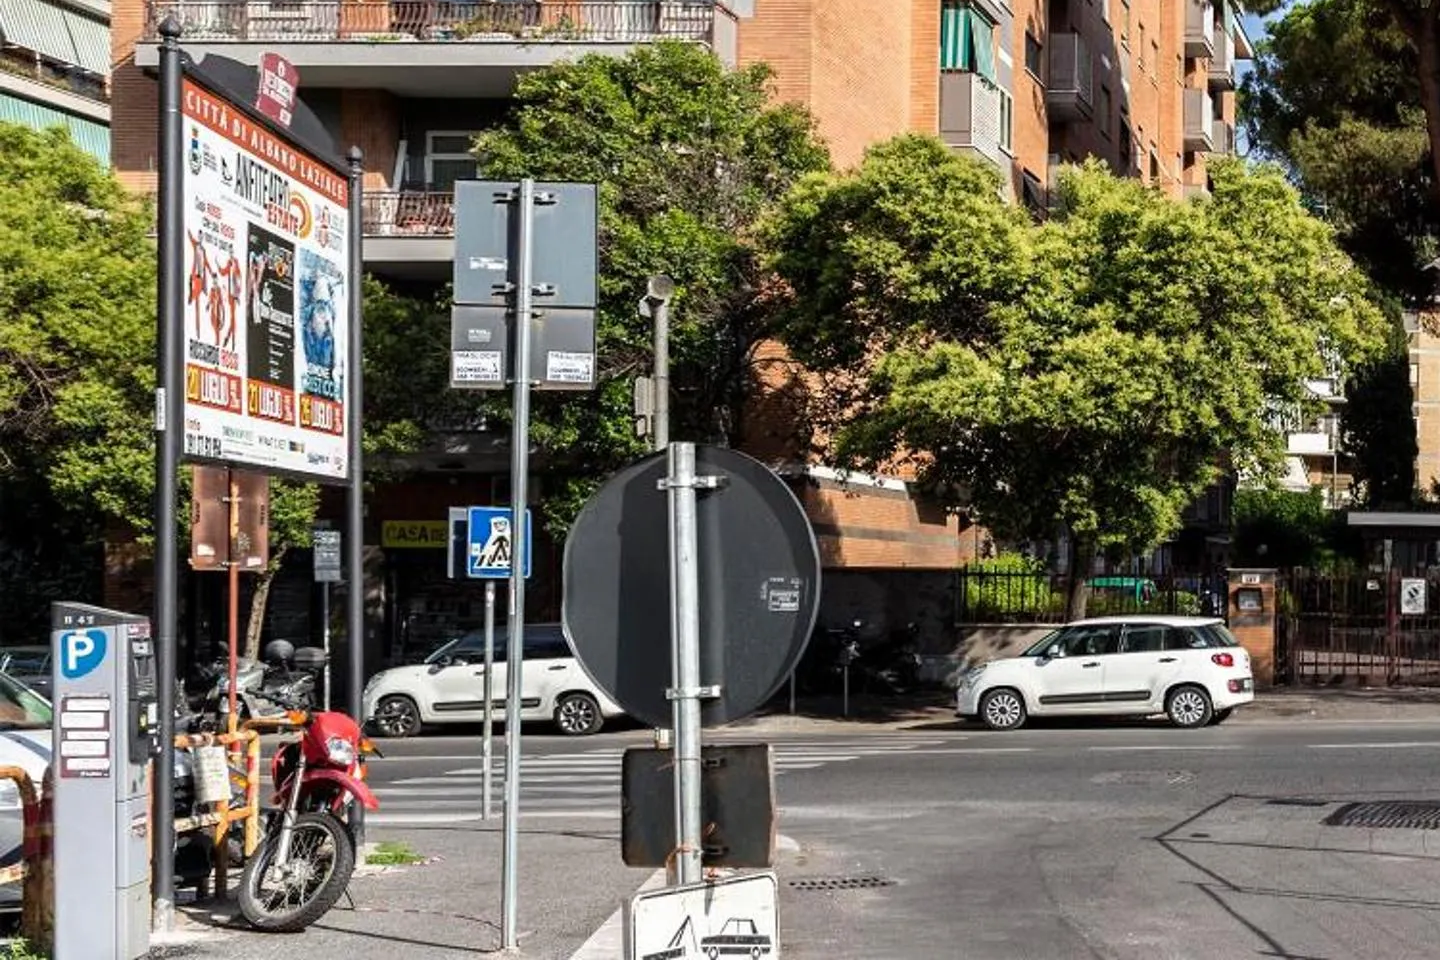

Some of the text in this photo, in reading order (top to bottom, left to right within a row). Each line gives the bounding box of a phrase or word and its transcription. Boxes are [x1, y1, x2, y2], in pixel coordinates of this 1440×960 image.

[185, 90, 228, 131] CITTÀ
[232, 118, 247, 141] DI
[251, 130, 297, 171] ALBANO
[300, 160, 344, 200] LAZIALE
[267, 203, 299, 237] ESTATE
[67, 634, 95, 671] P
